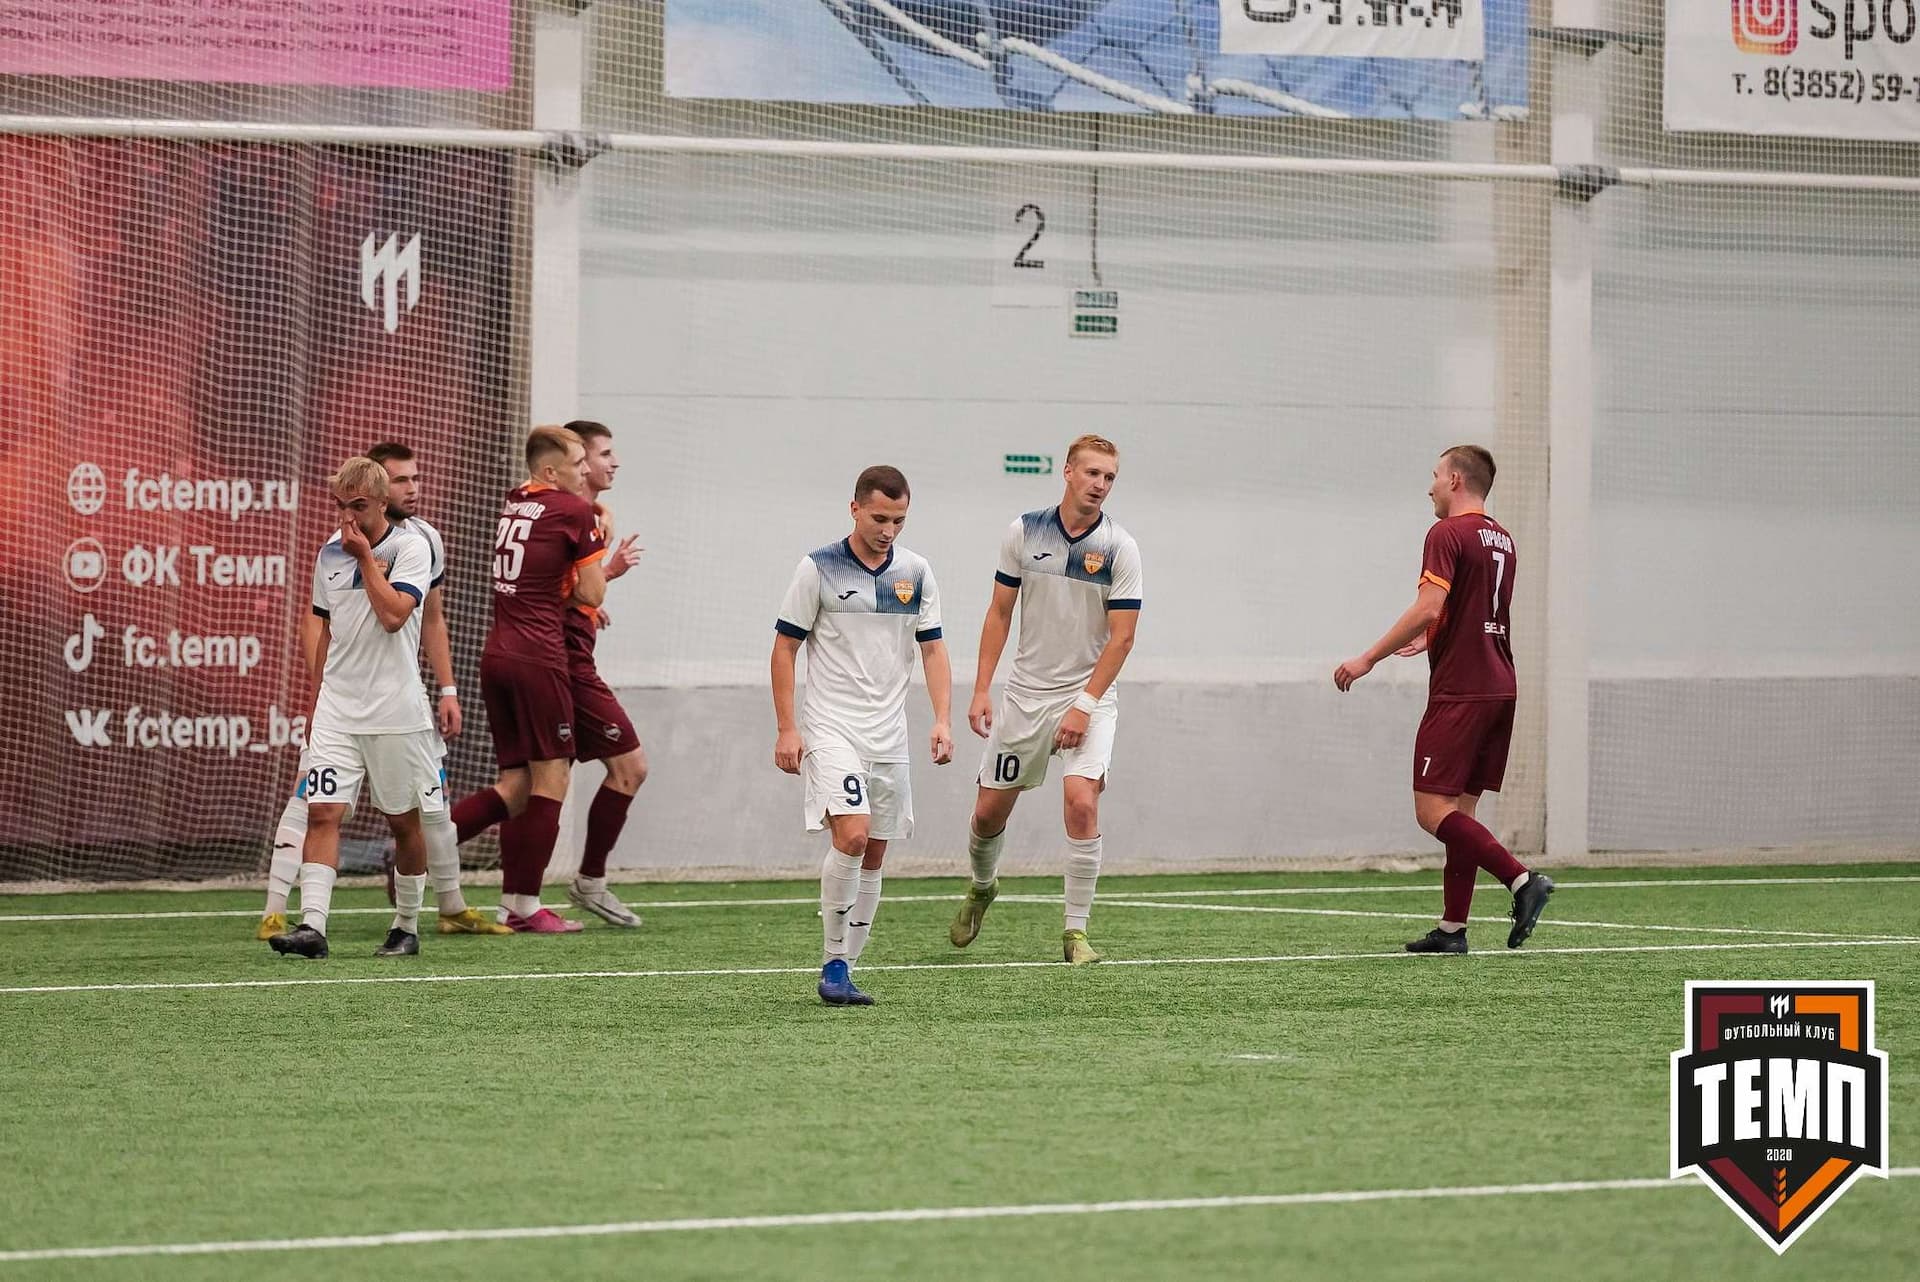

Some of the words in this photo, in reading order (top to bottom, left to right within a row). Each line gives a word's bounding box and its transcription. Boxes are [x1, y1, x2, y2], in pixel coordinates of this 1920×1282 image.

[1764, 65, 1866, 104] 8(3852)
[1013, 203, 1045, 268] 2
[123, 467, 299, 522] fctemp.ru
[121, 544, 181, 587] ФК
[189, 545, 286, 587] Темп
[1492, 551, 1506, 618] 7
[122, 624, 261, 677] fc.temp
[308, 767, 338, 797] 96
[994, 753, 1020, 782] 10
[1422, 757, 1431, 777] 7
[843, 775, 863, 807] 9
